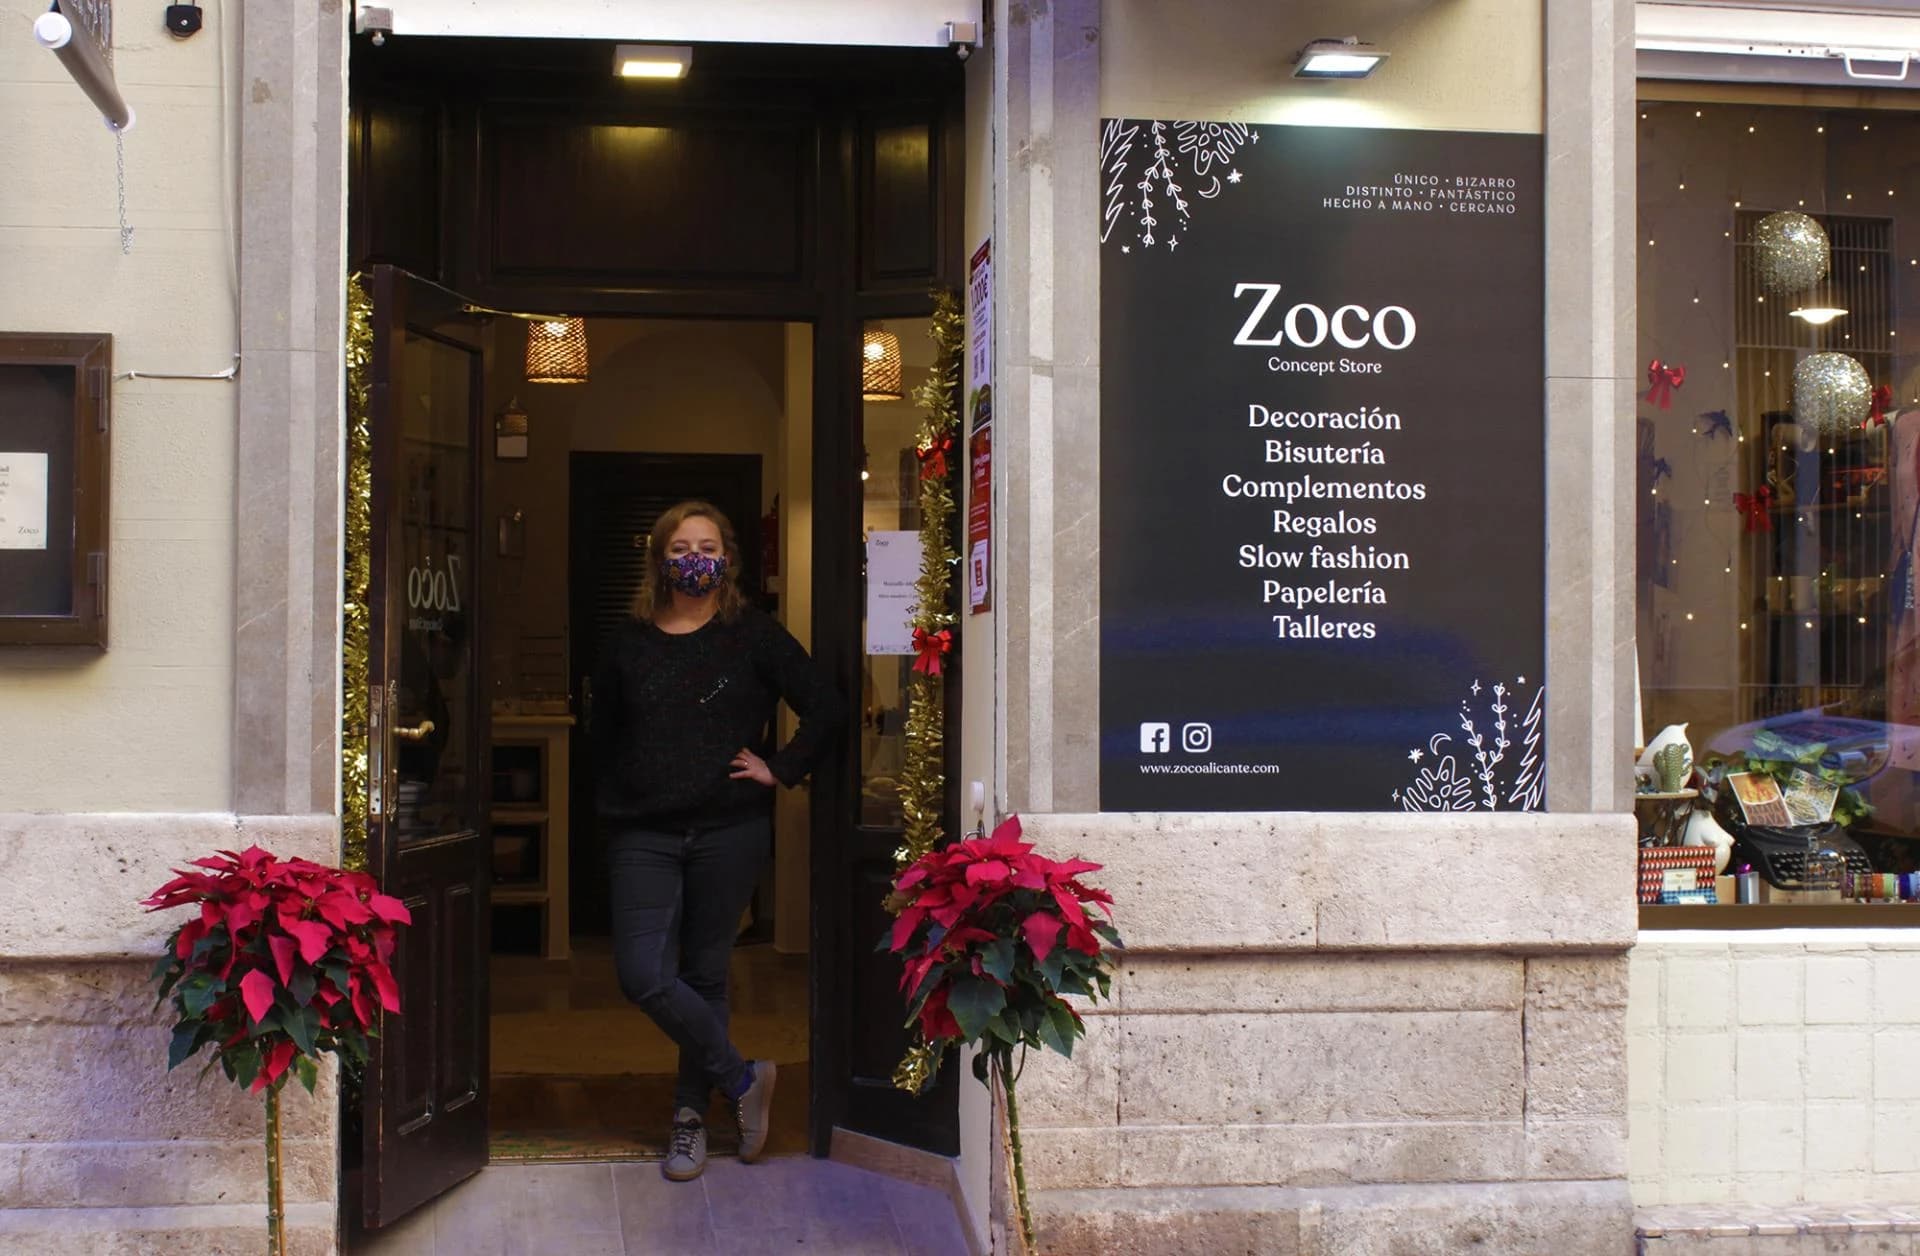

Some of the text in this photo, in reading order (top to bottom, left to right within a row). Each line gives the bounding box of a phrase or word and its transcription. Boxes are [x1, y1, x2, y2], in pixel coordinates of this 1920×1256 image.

[1394, 172, 1516, 188] ÚNICO BIZARRO
[1346, 185, 1516, 201] DISTINTO FANTÁSTICO
[1323, 198, 1516, 214] HECHO A MANO CERCANO
[1268, 356, 1382, 376] Concept Store
[1248, 404, 1402, 430] Decoración
[1265, 439, 1386, 465] Bisutería
[1222, 474, 1426, 504] Complementos
[1273, 509, 1377, 537] Regalos
[1238, 543, 1410, 570] Slow fashion
[1263, 579, 1387, 609] Papelería
[1272, 614, 1376, 639] Talleres
[1139, 762, 1280, 774] www.zocoalicante.com
